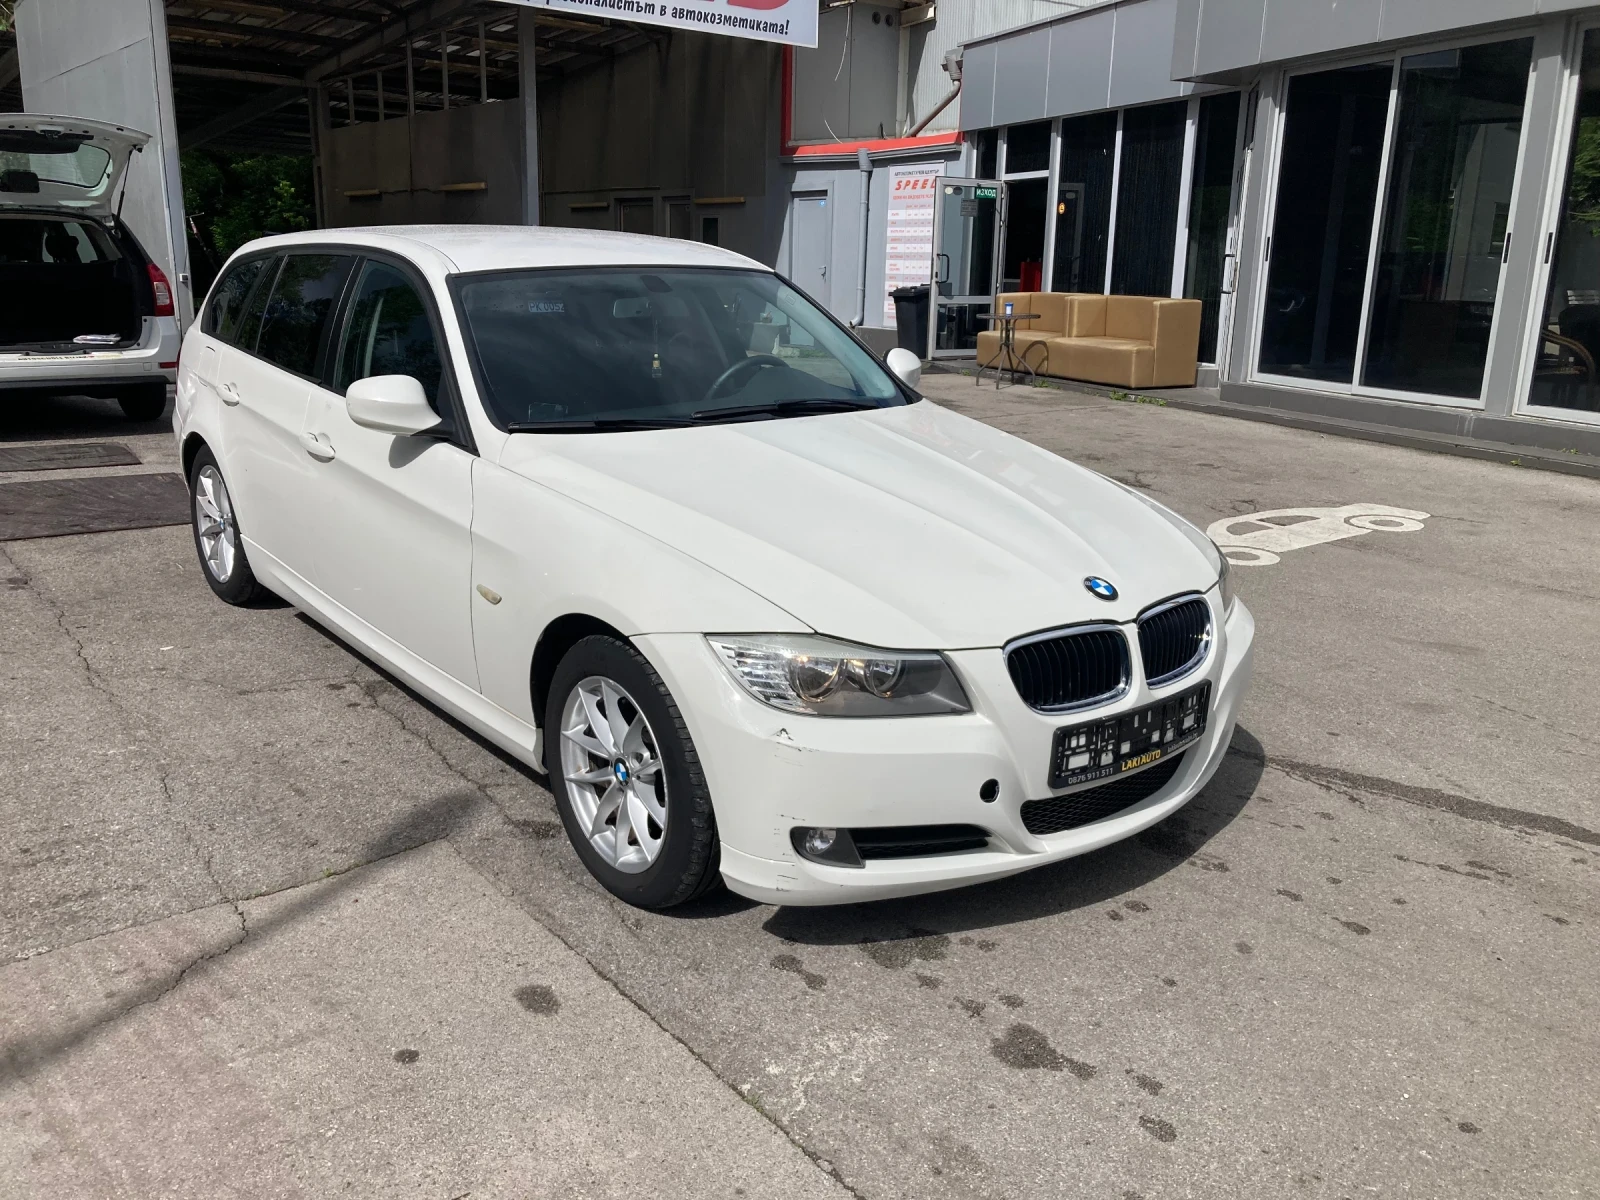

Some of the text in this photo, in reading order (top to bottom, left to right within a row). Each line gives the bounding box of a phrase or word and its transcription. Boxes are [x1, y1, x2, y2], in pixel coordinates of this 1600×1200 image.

[660, 4, 667, 16] в
[671, 6, 790, 35] автокозметиката!
[977, 188, 996, 197] ИЗХОД
[1068, 775, 1086, 785] 0876
[1087, 771, 1100, 780] 911
[1101, 767, 1113, 777] 511
